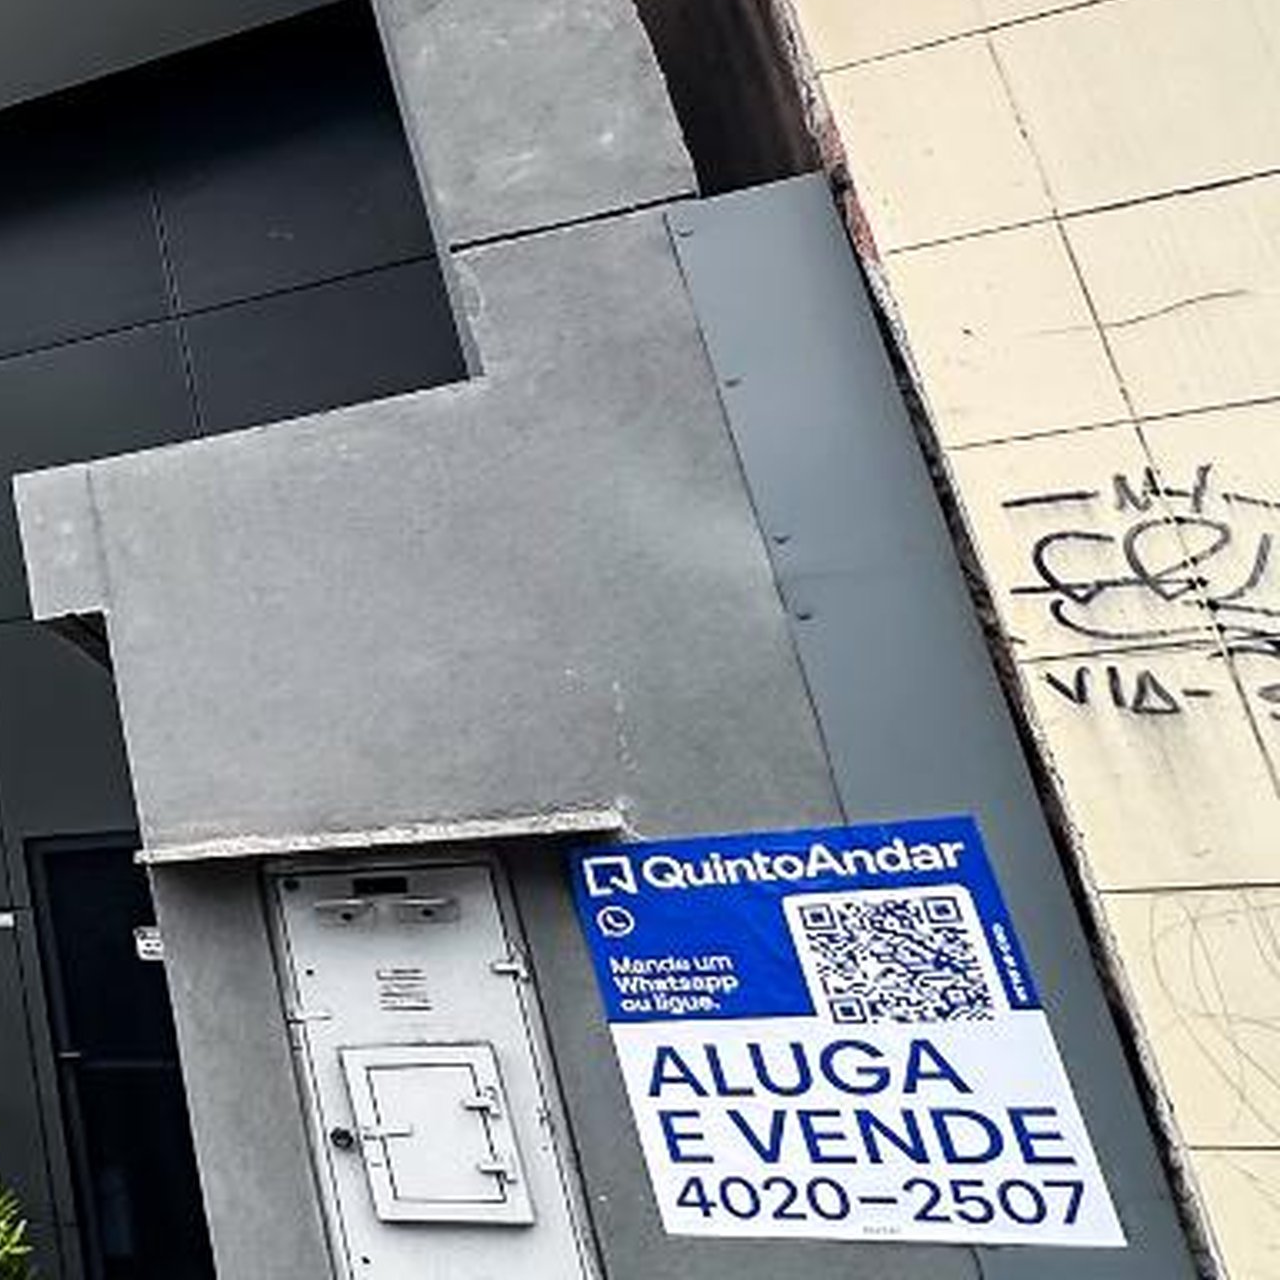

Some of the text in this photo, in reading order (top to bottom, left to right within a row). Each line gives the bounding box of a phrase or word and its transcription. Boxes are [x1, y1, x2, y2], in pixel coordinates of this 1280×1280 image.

[642, 837, 966, 891] QuintoAndar
[609, 954, 734, 974] Mande um
[612, 975, 739, 995] Whatsapp
[620, 998, 652, 1013] ou
[648, 1038, 974, 1099] ALUGA
[659, 1106, 1078, 1167] E VENDE
[676, 1175, 1086, 1226] 4020-2507
